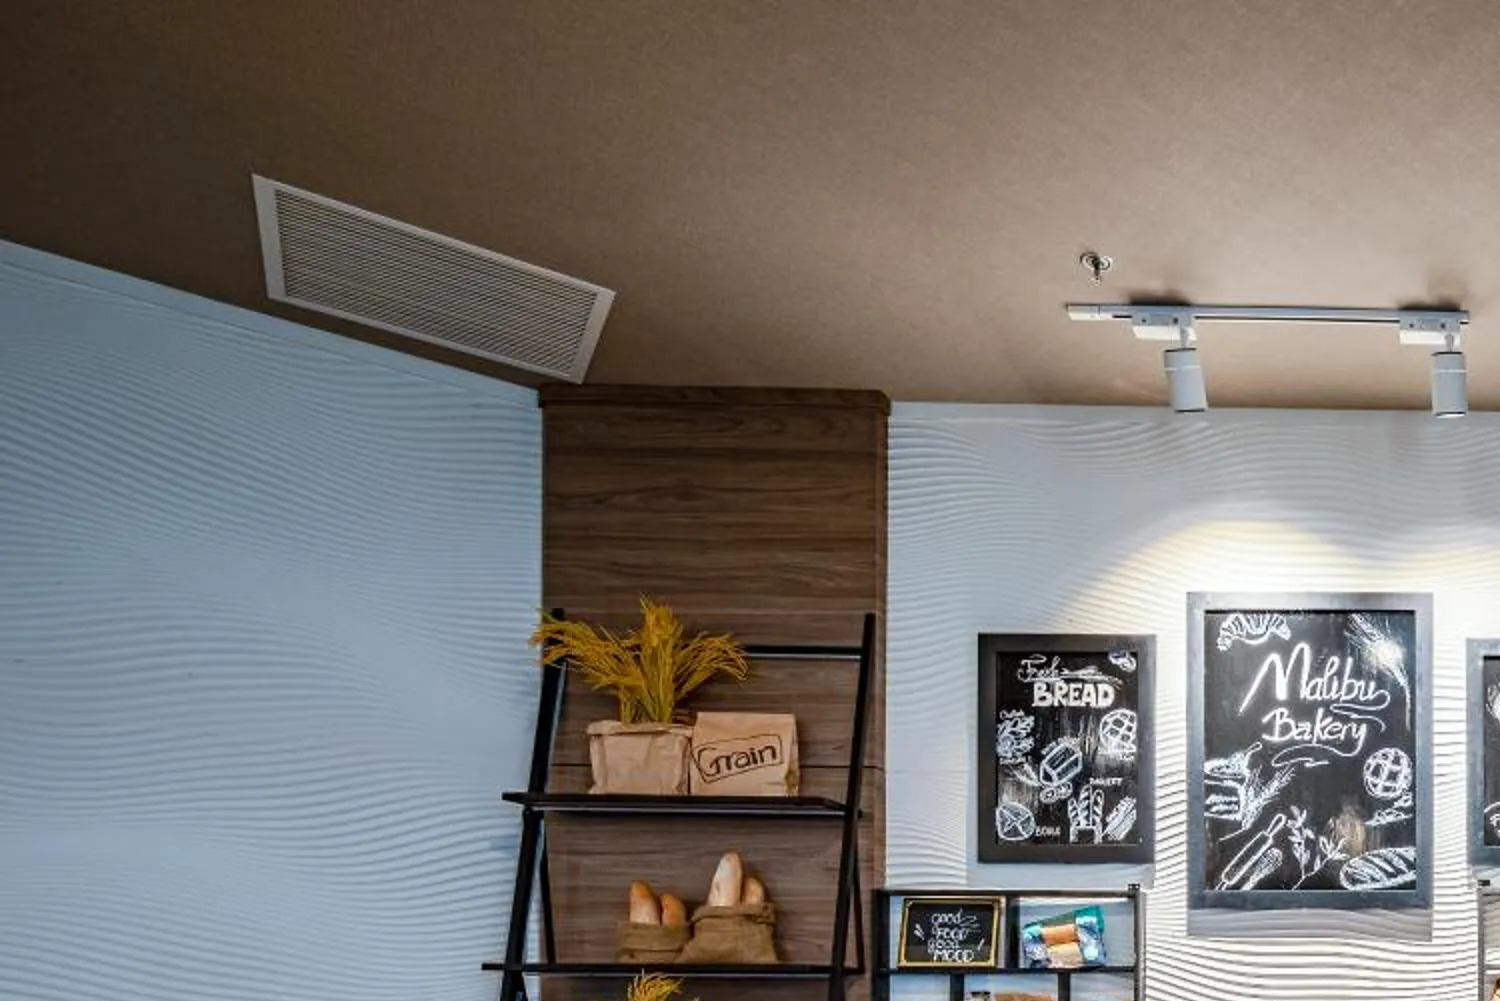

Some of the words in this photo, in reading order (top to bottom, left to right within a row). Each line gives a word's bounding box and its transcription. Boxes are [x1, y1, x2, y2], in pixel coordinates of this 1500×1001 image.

[1031, 681, 1116, 708] BREAD
[1237, 642, 1391, 713] Malibu
[1261, 708, 1368, 757] Bakery
[697, 744, 778, 777] Grain
